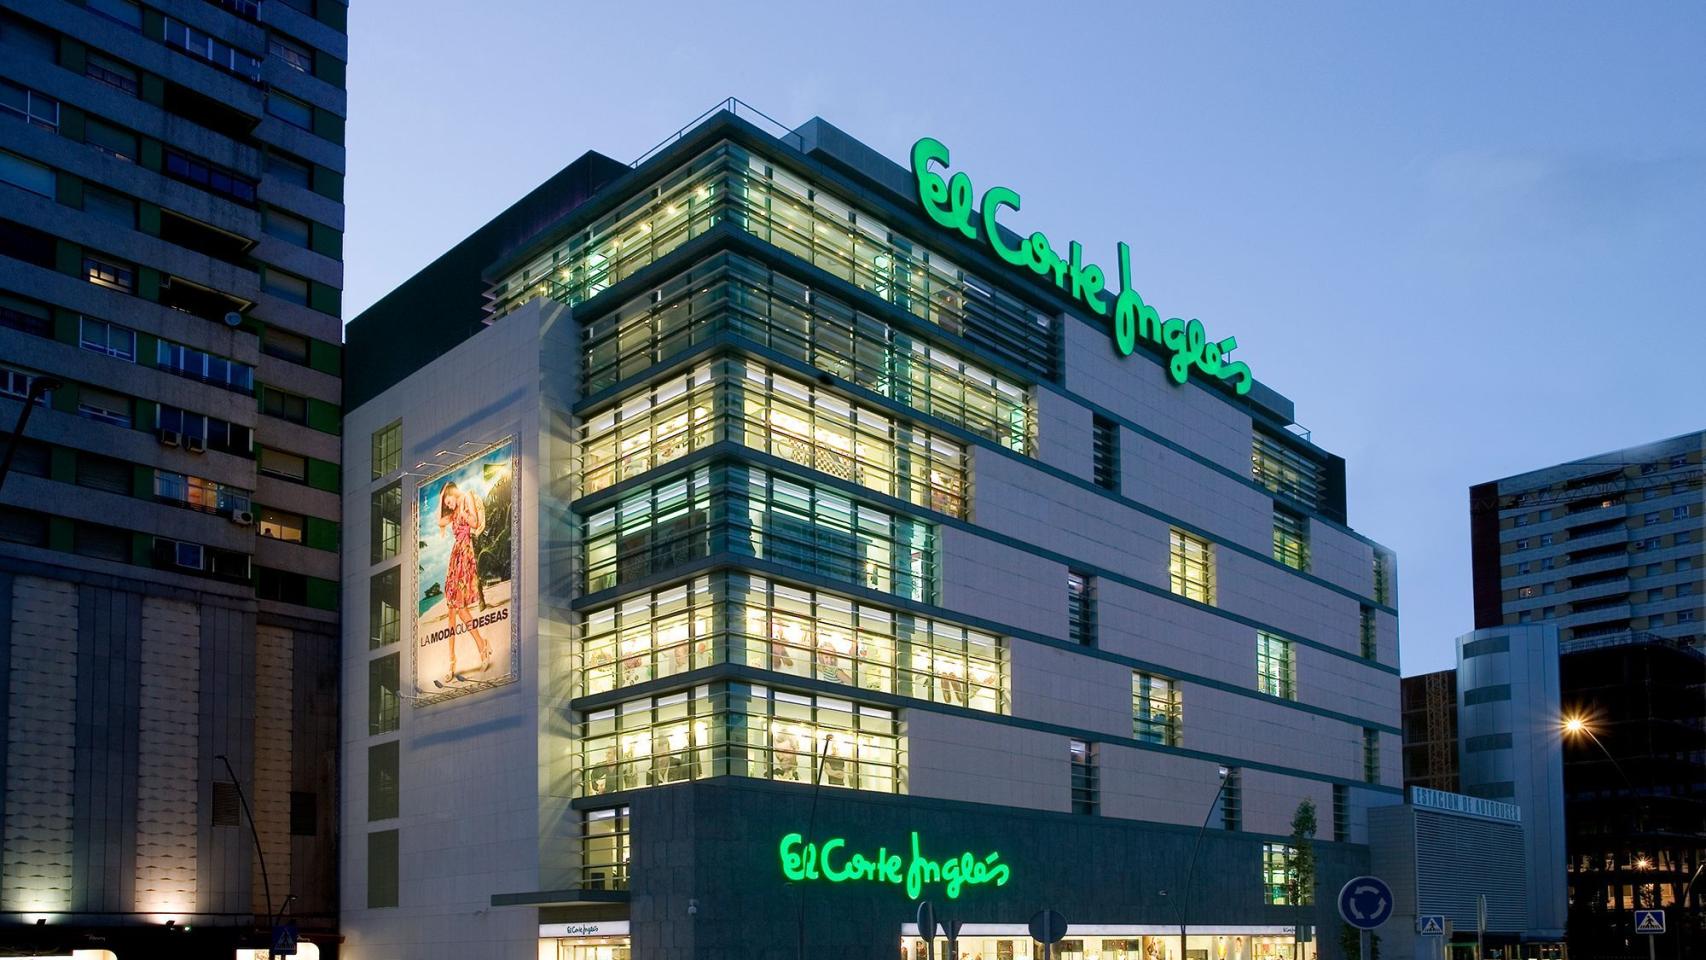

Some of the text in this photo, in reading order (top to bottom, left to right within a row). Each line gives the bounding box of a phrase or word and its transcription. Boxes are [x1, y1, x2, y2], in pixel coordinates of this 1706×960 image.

[910, 137, 1252, 396] El Corte Inglés
[431, 627, 455, 643] MODA
[472, 608, 508, 629] DESEAS
[1462, 796, 1472, 812] DE
[780, 831, 1009, 899] El Corte Inglés
